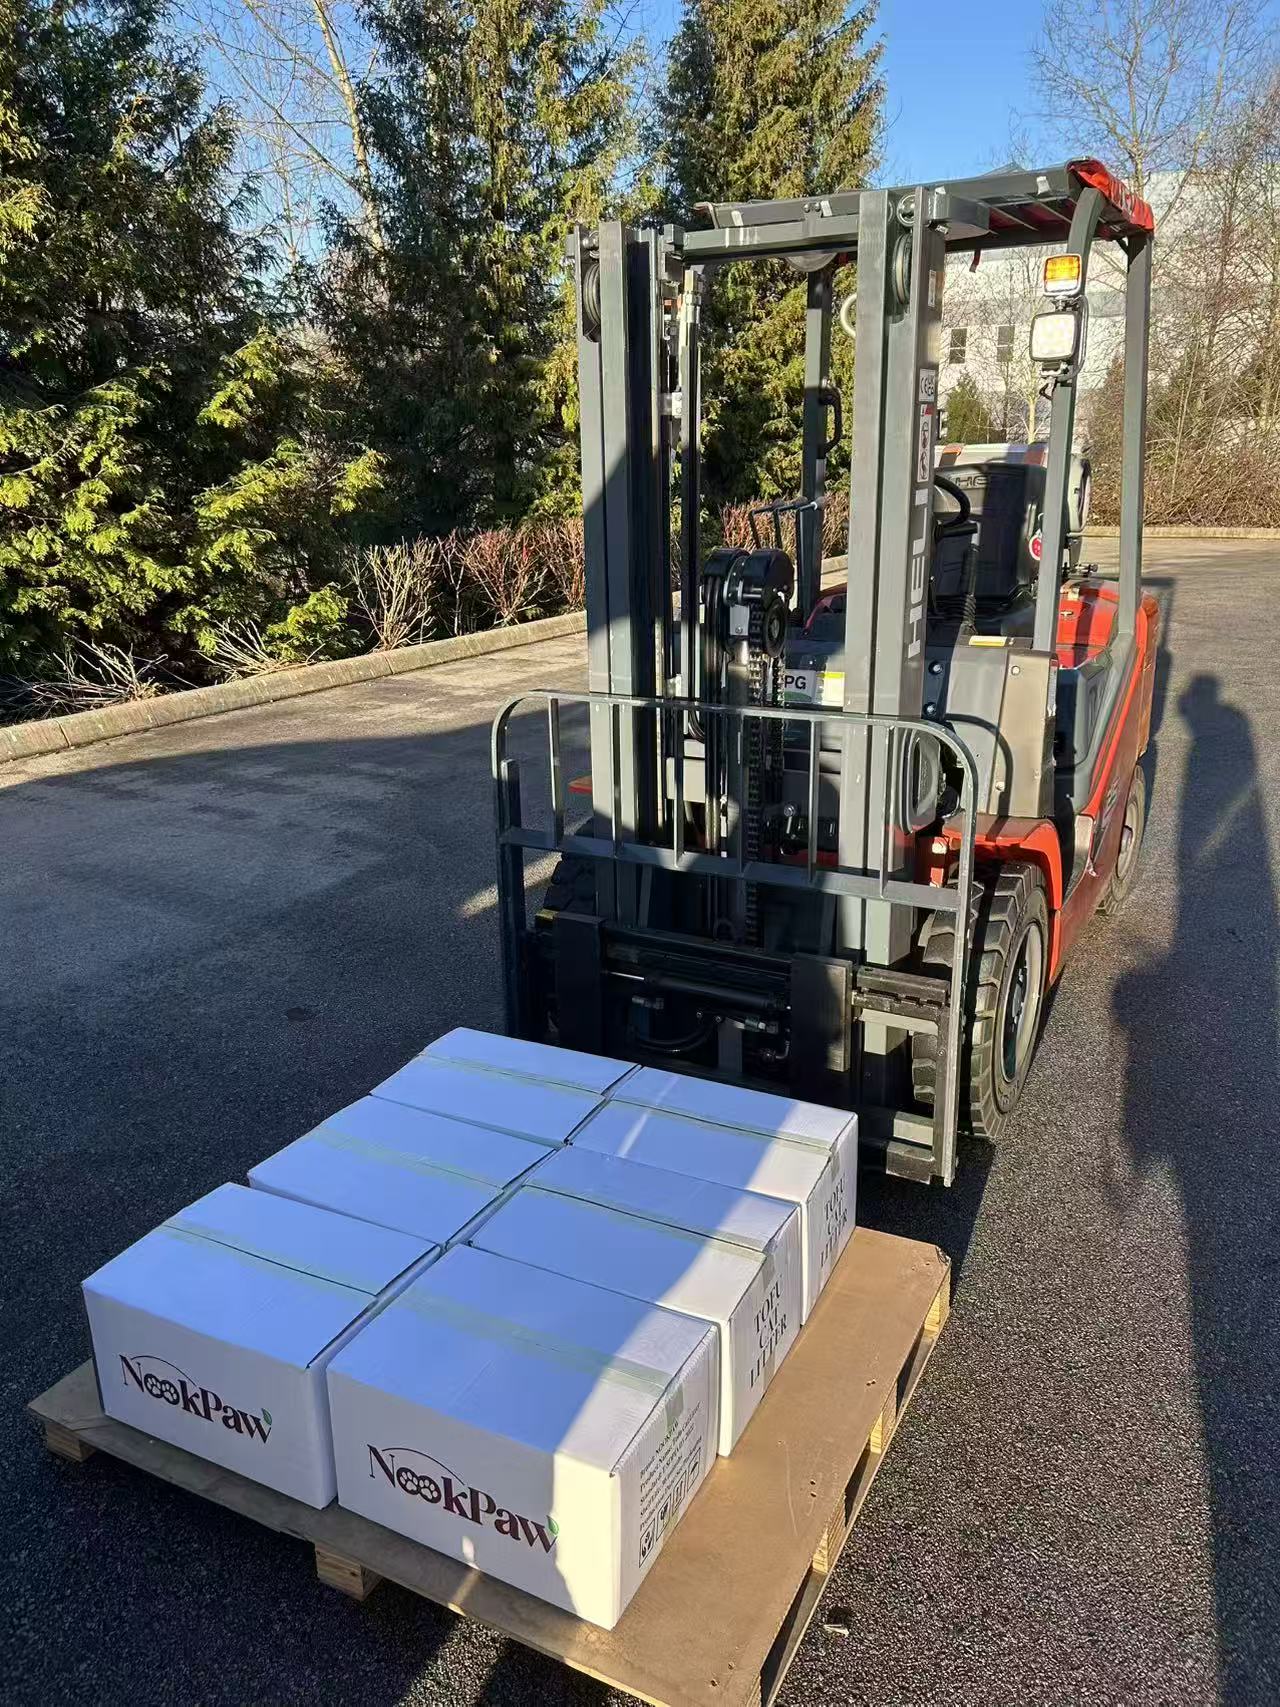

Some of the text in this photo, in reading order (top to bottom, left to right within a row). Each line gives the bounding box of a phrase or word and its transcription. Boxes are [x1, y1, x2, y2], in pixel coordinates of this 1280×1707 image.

[907, 488, 928, 659] HELI
[775, 674, 807, 690] PG
[753, 1273, 783, 1334] TOFU
[759, 1303, 780, 1350] CAT
[749, 1312, 787, 1389] LITTER
[119, 1353, 272, 1444] NookPaw
[366, 1443, 558, 1554] NookPaw
